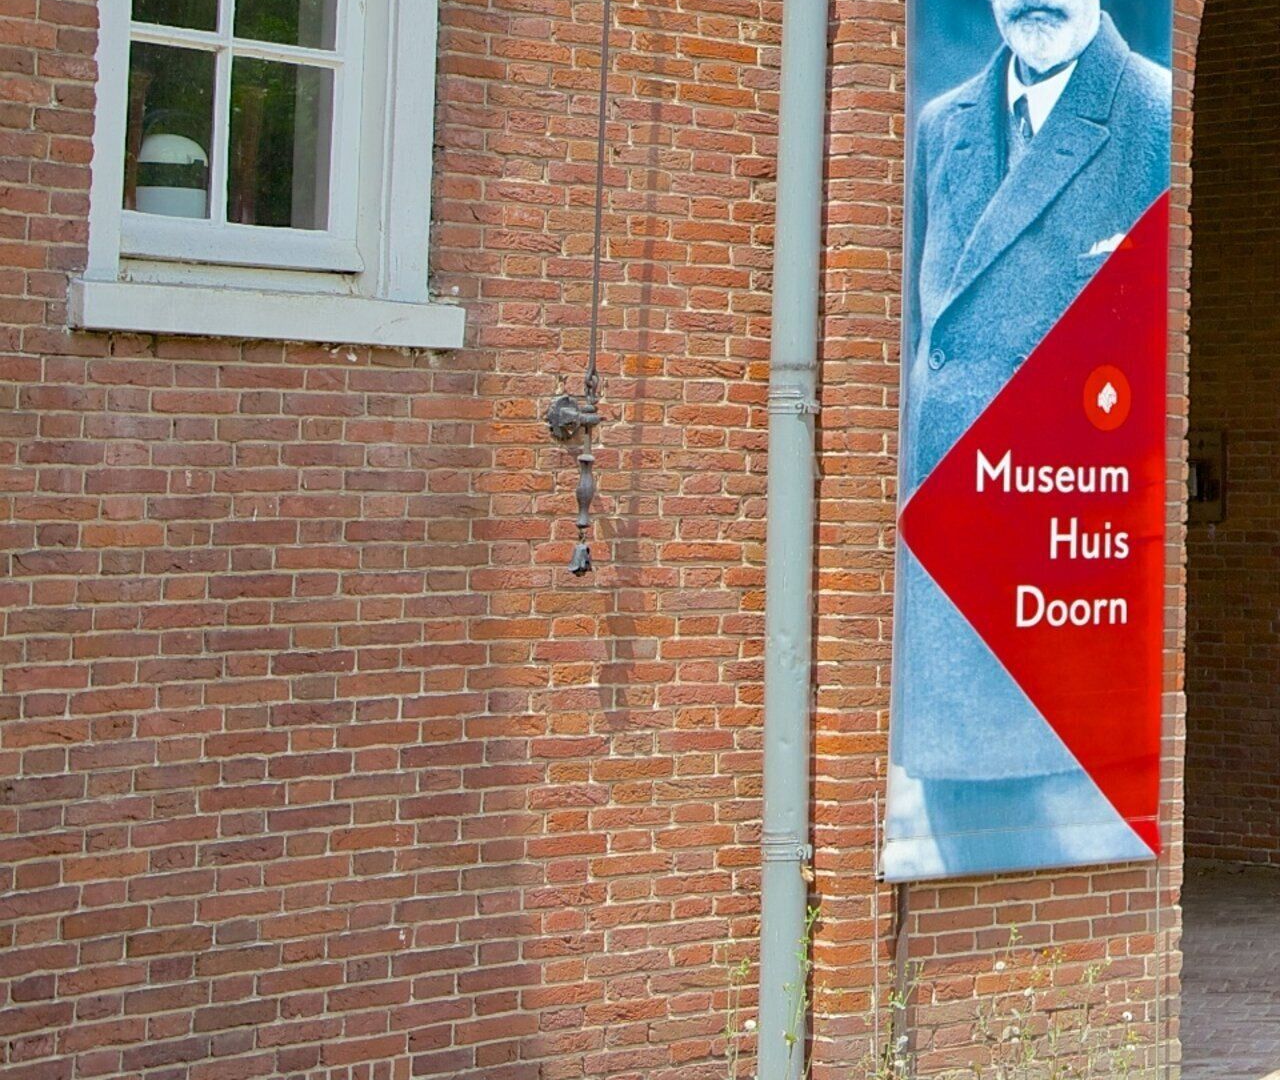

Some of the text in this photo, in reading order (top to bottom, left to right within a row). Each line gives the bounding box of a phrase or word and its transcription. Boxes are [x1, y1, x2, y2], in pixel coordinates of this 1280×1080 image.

[976, 449, 1129, 493] Museum
[1050, 517, 1130, 560] Huis
[1016, 584, 1128, 628] Doorn
